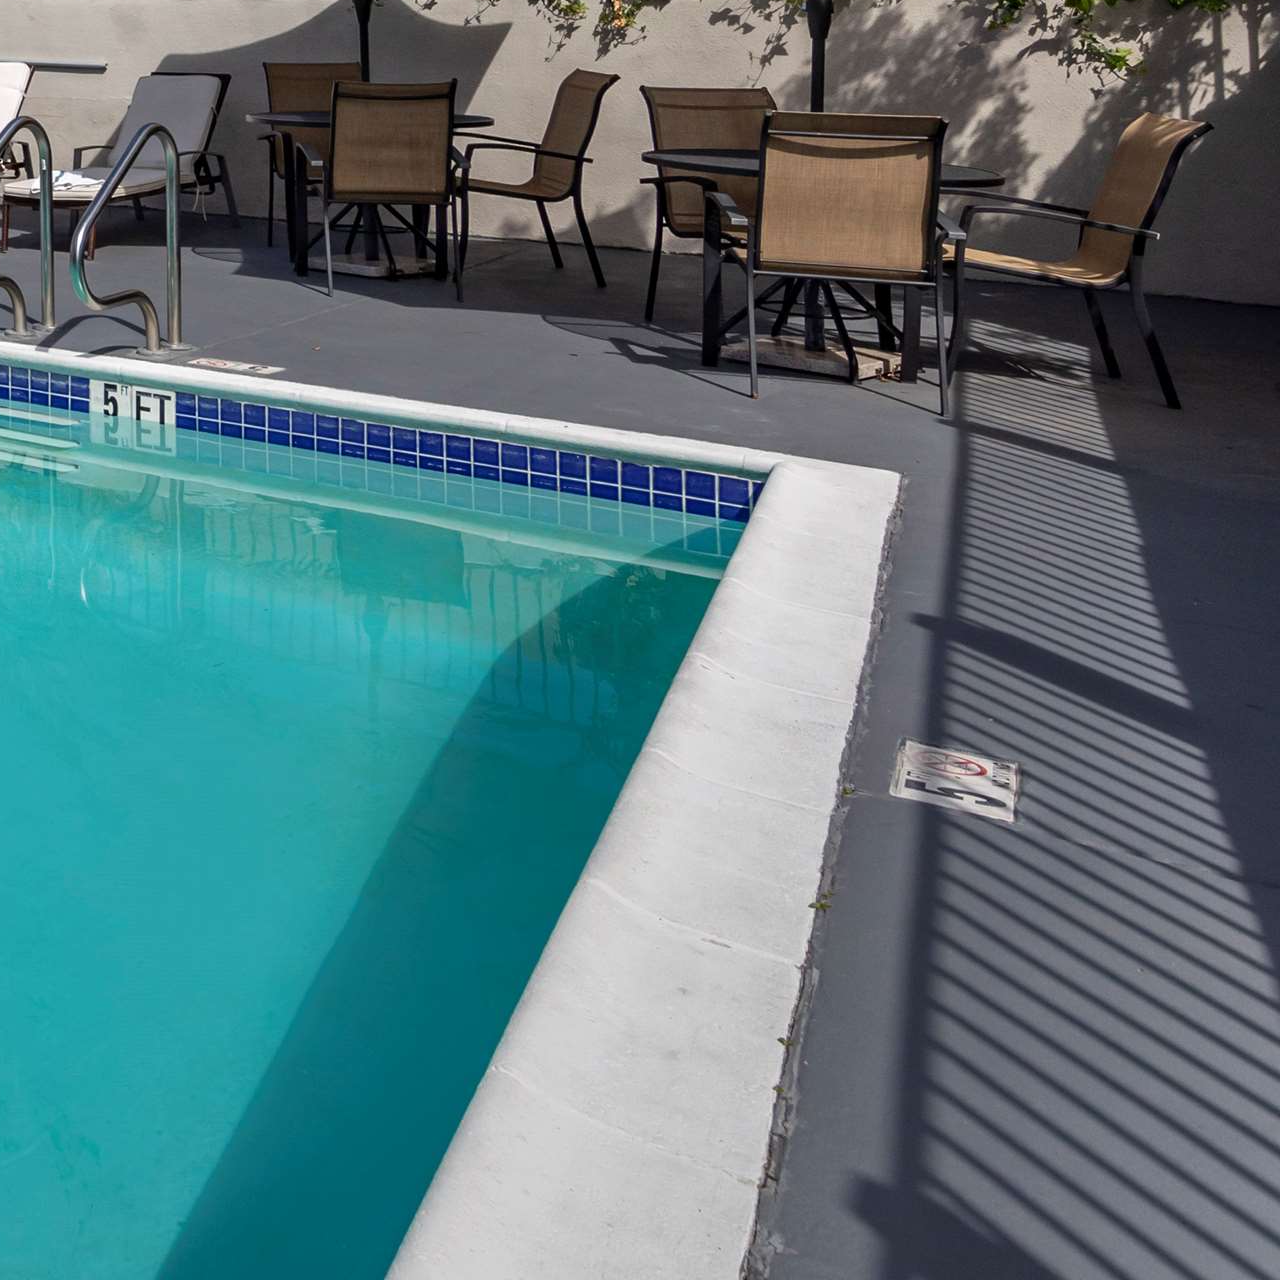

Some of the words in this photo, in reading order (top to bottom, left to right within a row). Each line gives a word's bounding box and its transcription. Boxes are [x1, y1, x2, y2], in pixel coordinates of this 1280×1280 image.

[104, 383, 118, 416] 5
[136, 391, 171, 424] FT
[904, 779, 1007, 808] 5
